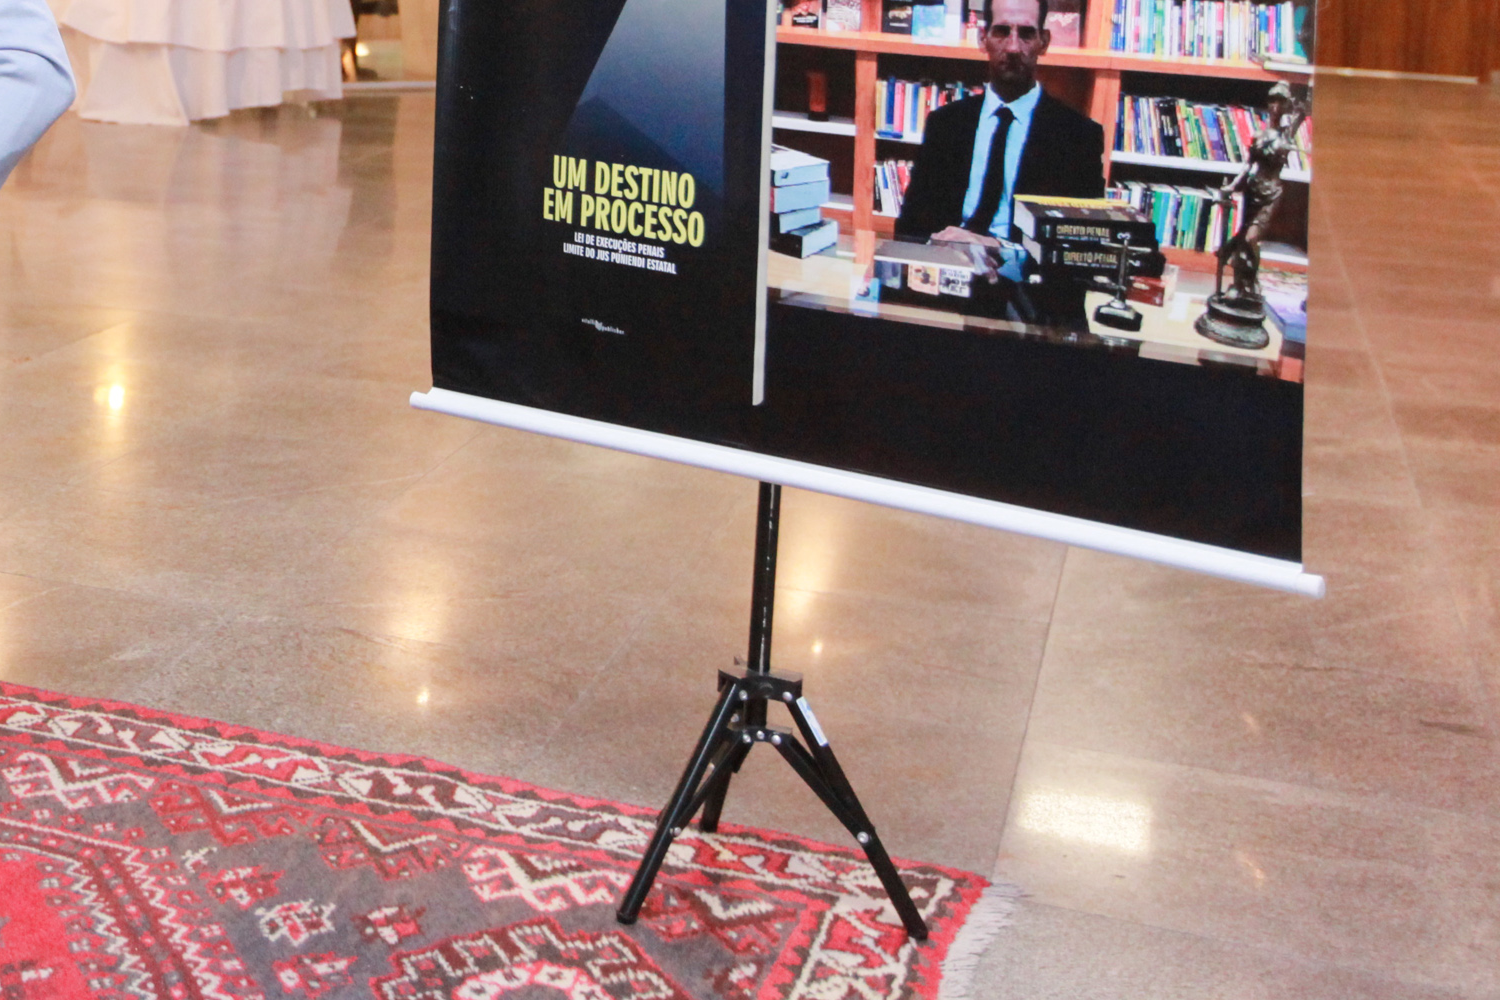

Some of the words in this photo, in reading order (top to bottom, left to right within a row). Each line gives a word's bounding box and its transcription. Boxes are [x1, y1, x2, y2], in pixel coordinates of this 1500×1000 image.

[553, 154, 587, 192] UM
[594, 161, 696, 209] DESTINO
[543, 187, 574, 224] EM
[580, 194, 705, 247] PROCESSO
[563, 242, 584, 257] LIMITE
[585, 246, 596, 259] DO
[596, 249, 610, 261] JUS
[611, 251, 646, 269] PUNIENDI
[646, 259, 678, 275] ESTATAL
[574, 231, 585, 243] LEI
[585, 234, 595, 245] DE
[595, 235, 637, 253] EXECUÇÕES
[637, 243, 666, 258] PENAIS
